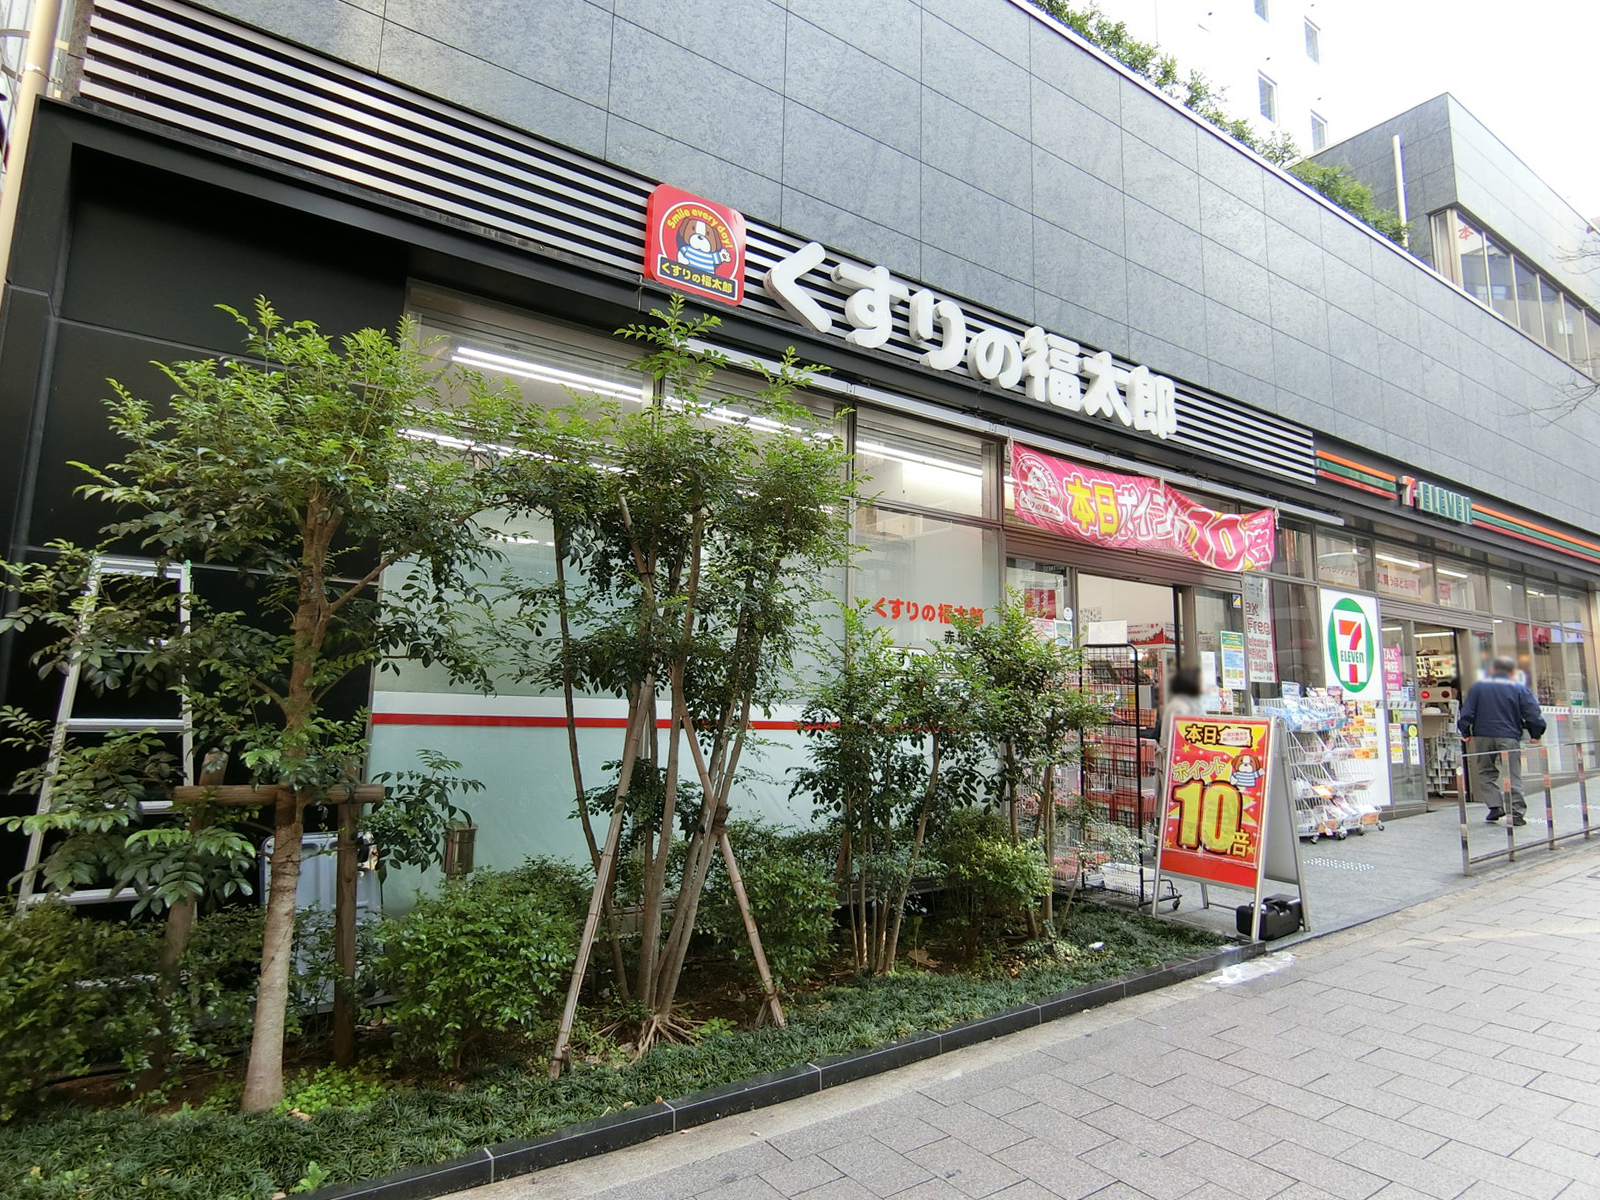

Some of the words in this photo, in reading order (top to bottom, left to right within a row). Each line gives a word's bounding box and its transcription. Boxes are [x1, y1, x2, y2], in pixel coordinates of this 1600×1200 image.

[667, 208, 690, 229] Smile
[691, 208, 718, 228] every
[717, 225, 734, 249] day!
[661, 262, 733, 294] くすりの福太郎
[763, 241, 1177, 440] くすりの福太郎
[1173, 757, 1226, 780] ポイント
